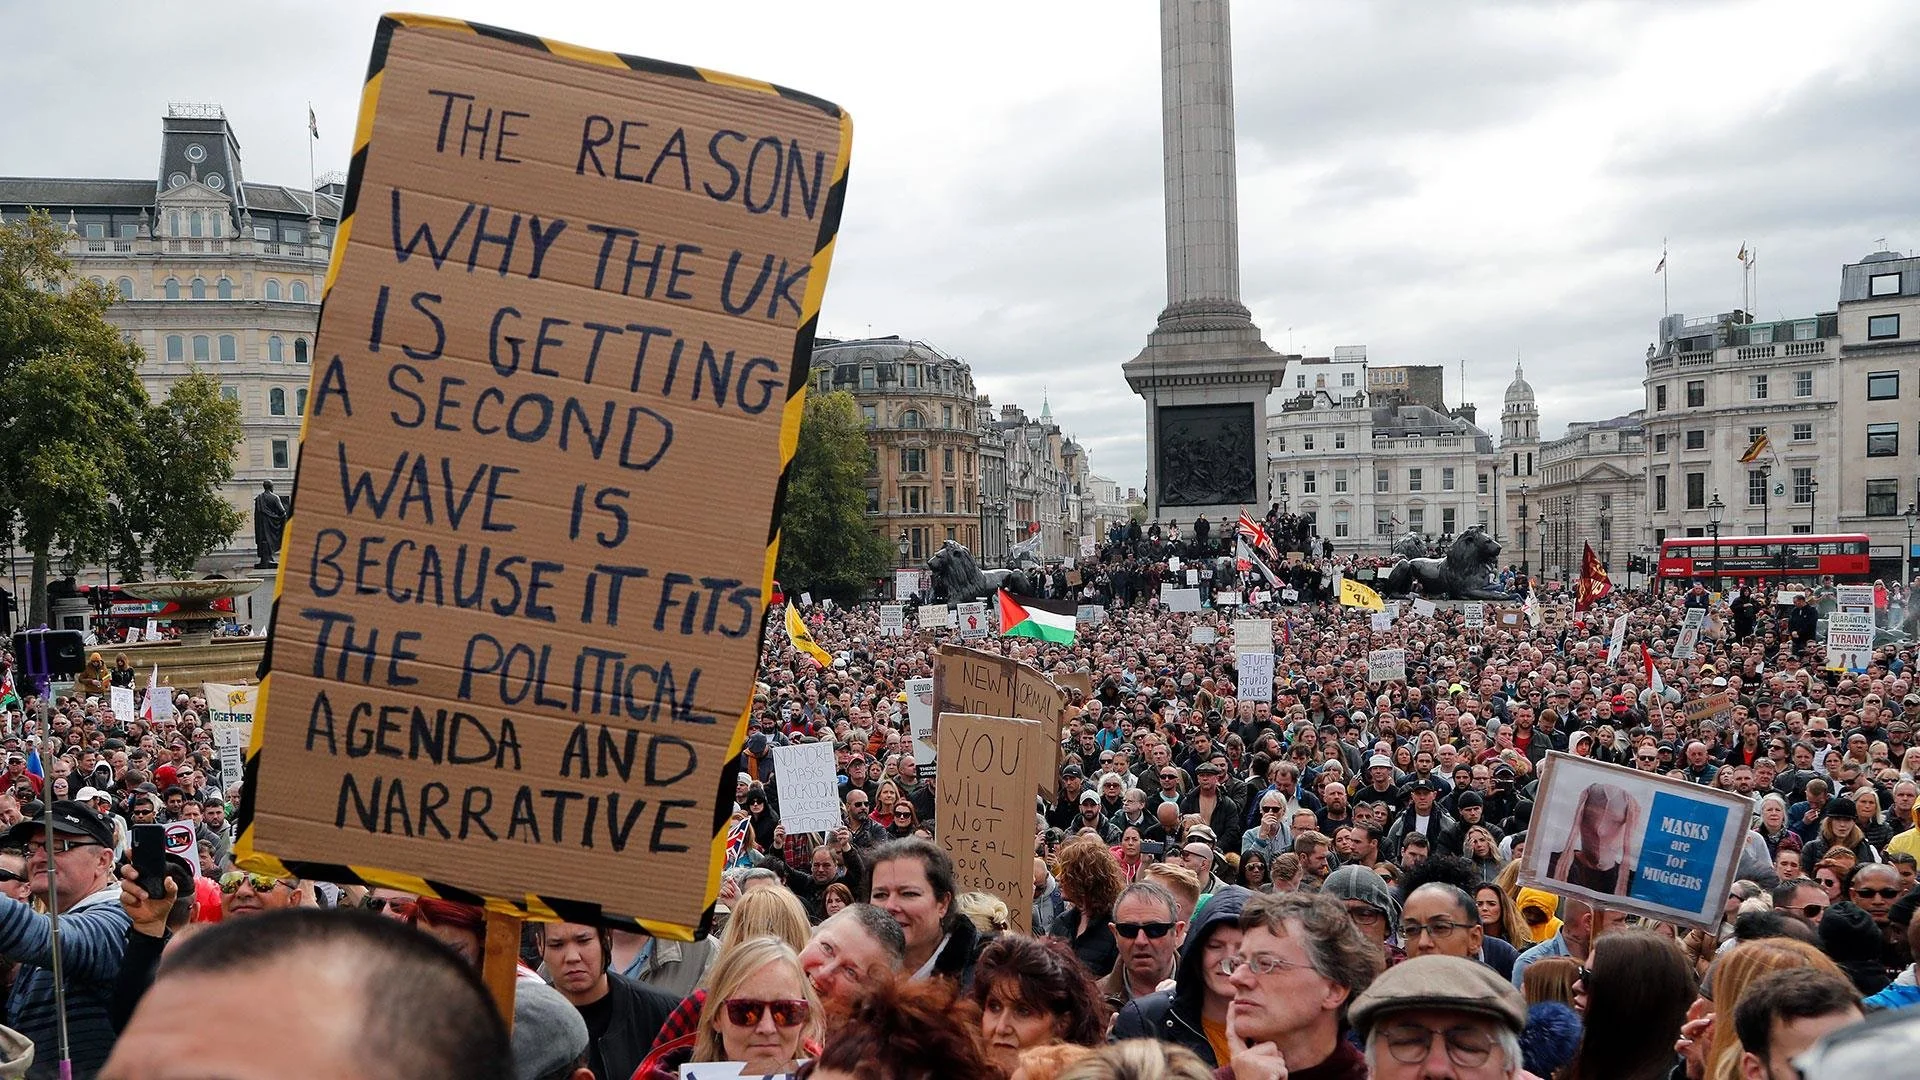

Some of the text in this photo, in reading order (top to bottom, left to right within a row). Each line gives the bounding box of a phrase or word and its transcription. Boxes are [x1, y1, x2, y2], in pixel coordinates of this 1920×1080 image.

[428, 88, 824, 222] THE REASON
[391, 189, 811, 319] WHY THE UK
[369, 286, 784, 415] IS GETTING
[314, 355, 674, 472] A SECOND
[339, 442, 629, 549] WAVE IS
[309, 528, 758, 641] BECAUSE IT FITS
[1831, 615, 1872, 624] QUARANTINE
[1831, 634, 1870, 644] TYRANNY
[300, 609, 717, 727] THE POLITICAL
[1241, 654, 1272, 665] STUFF
[1245, 666, 1265, 674] THE
[962, 661, 1054, 723] NEW NORMAL
[1239, 677, 1268, 686] STUPID
[1242, 687, 1268, 697] RULES
[209, 709, 252, 723] TOGETHER
[306, 691, 522, 769] AGENDA
[567, 724, 698, 788] AND
[949, 727, 1023, 775] YOU
[786, 766, 824, 782] MASKS
[64, 814, 80, 823] Jeep
[337, 774, 698, 855] NARRATIVE
[951, 811, 1002, 833] NOT
[1660, 816, 1710, 841] MASKS
[945, 835, 1015, 859] STEAL
[1670, 840, 1691, 852] are
[958, 858, 991, 876] OUR
[1665, 854, 1687, 869] for
[1642, 866, 1703, 891] MUGGERS
